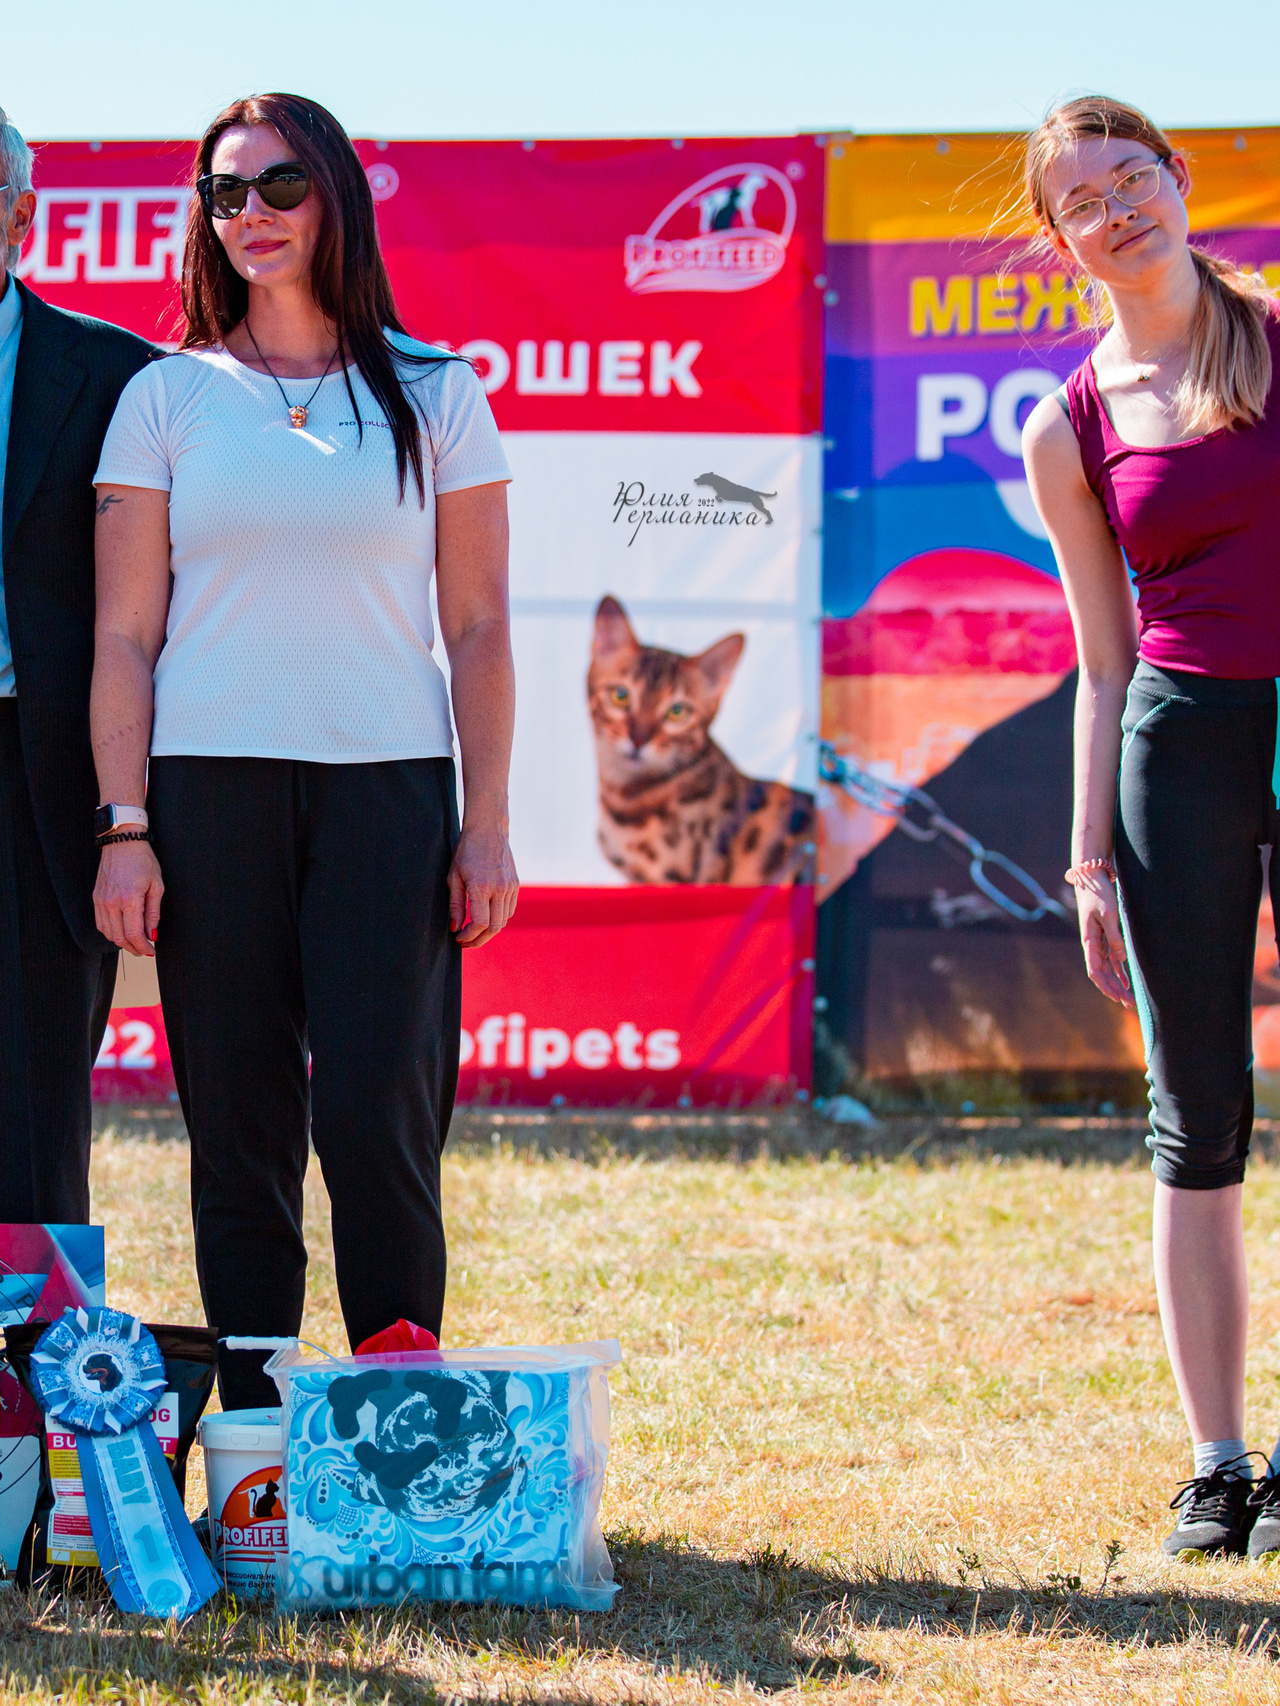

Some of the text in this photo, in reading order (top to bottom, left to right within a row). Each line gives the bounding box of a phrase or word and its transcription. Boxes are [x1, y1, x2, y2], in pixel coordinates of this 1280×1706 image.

[360, 420, 392, 430] COLLEC
[107, 1438, 152, 1505] BABY
[134, 1524, 161, 1563] 1
[322, 1554, 462, 1599] urban
